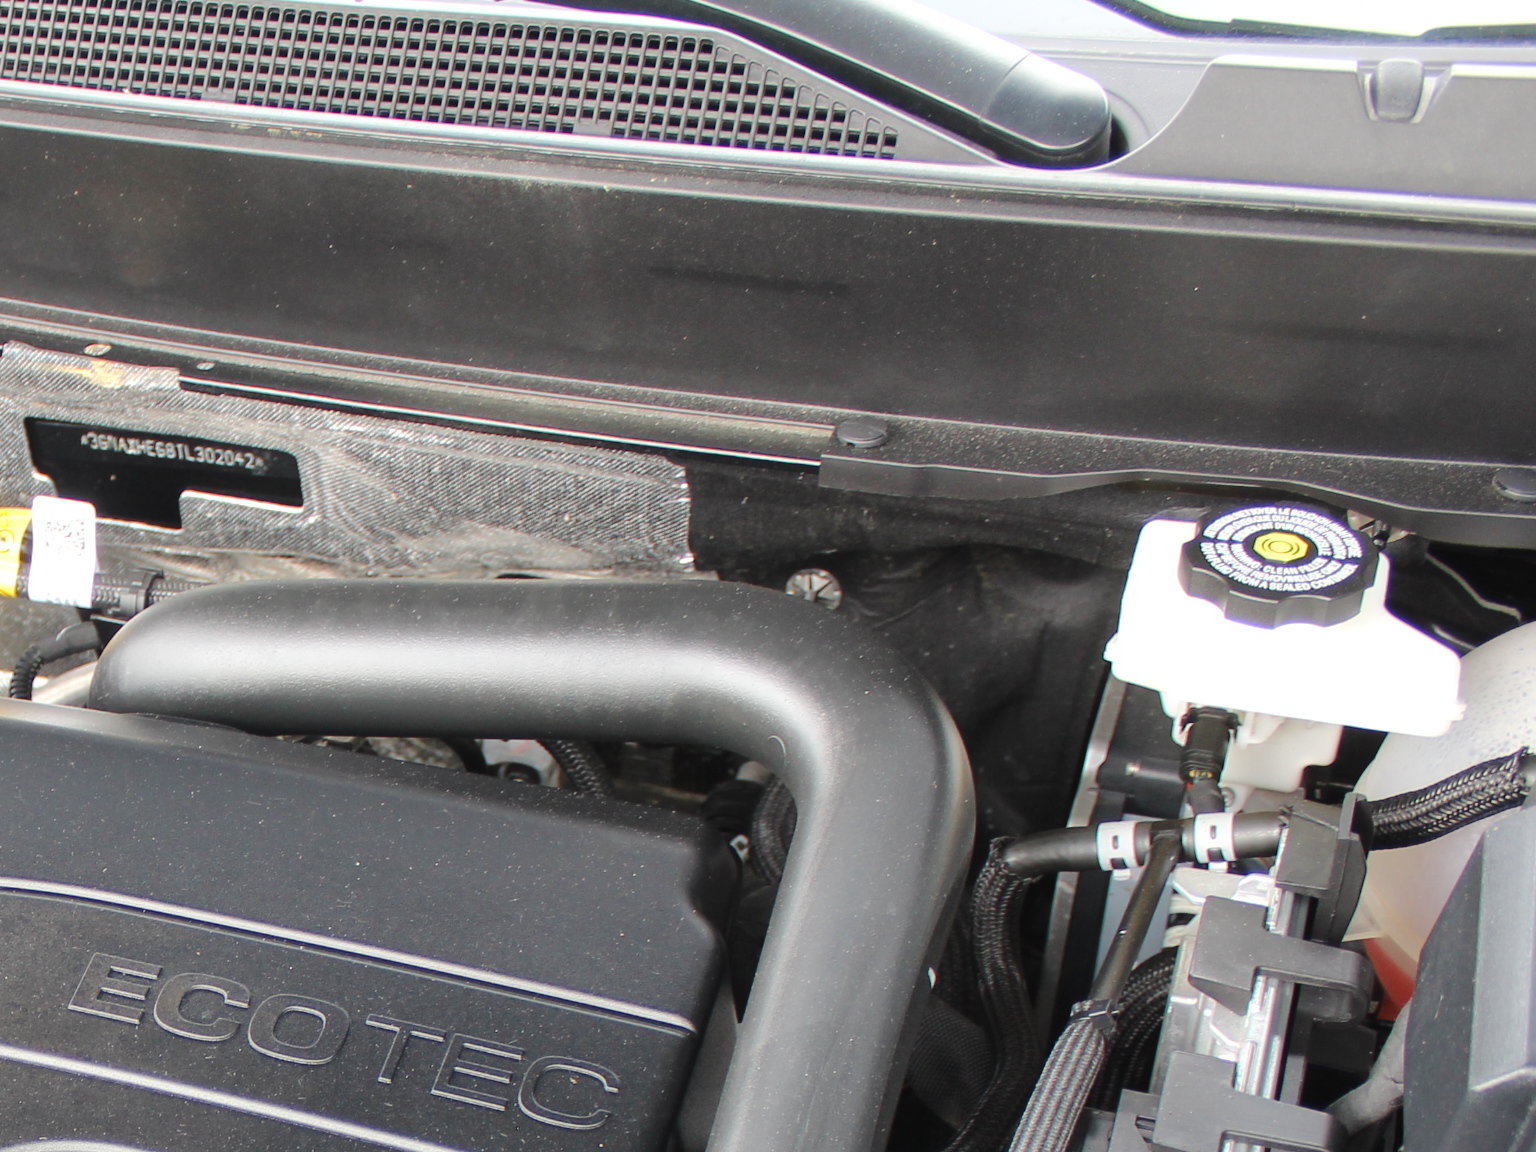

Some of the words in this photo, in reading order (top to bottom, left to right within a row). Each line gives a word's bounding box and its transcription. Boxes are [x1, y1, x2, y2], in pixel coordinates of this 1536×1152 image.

[1263, 565, 1299, 575] CLEAN
[1229, 571, 1261, 588] FROM
[1258, 581, 1269, 589] A
[1269, 583, 1311, 592] SEALED
[68, 952, 620, 1131] ECOTEC
